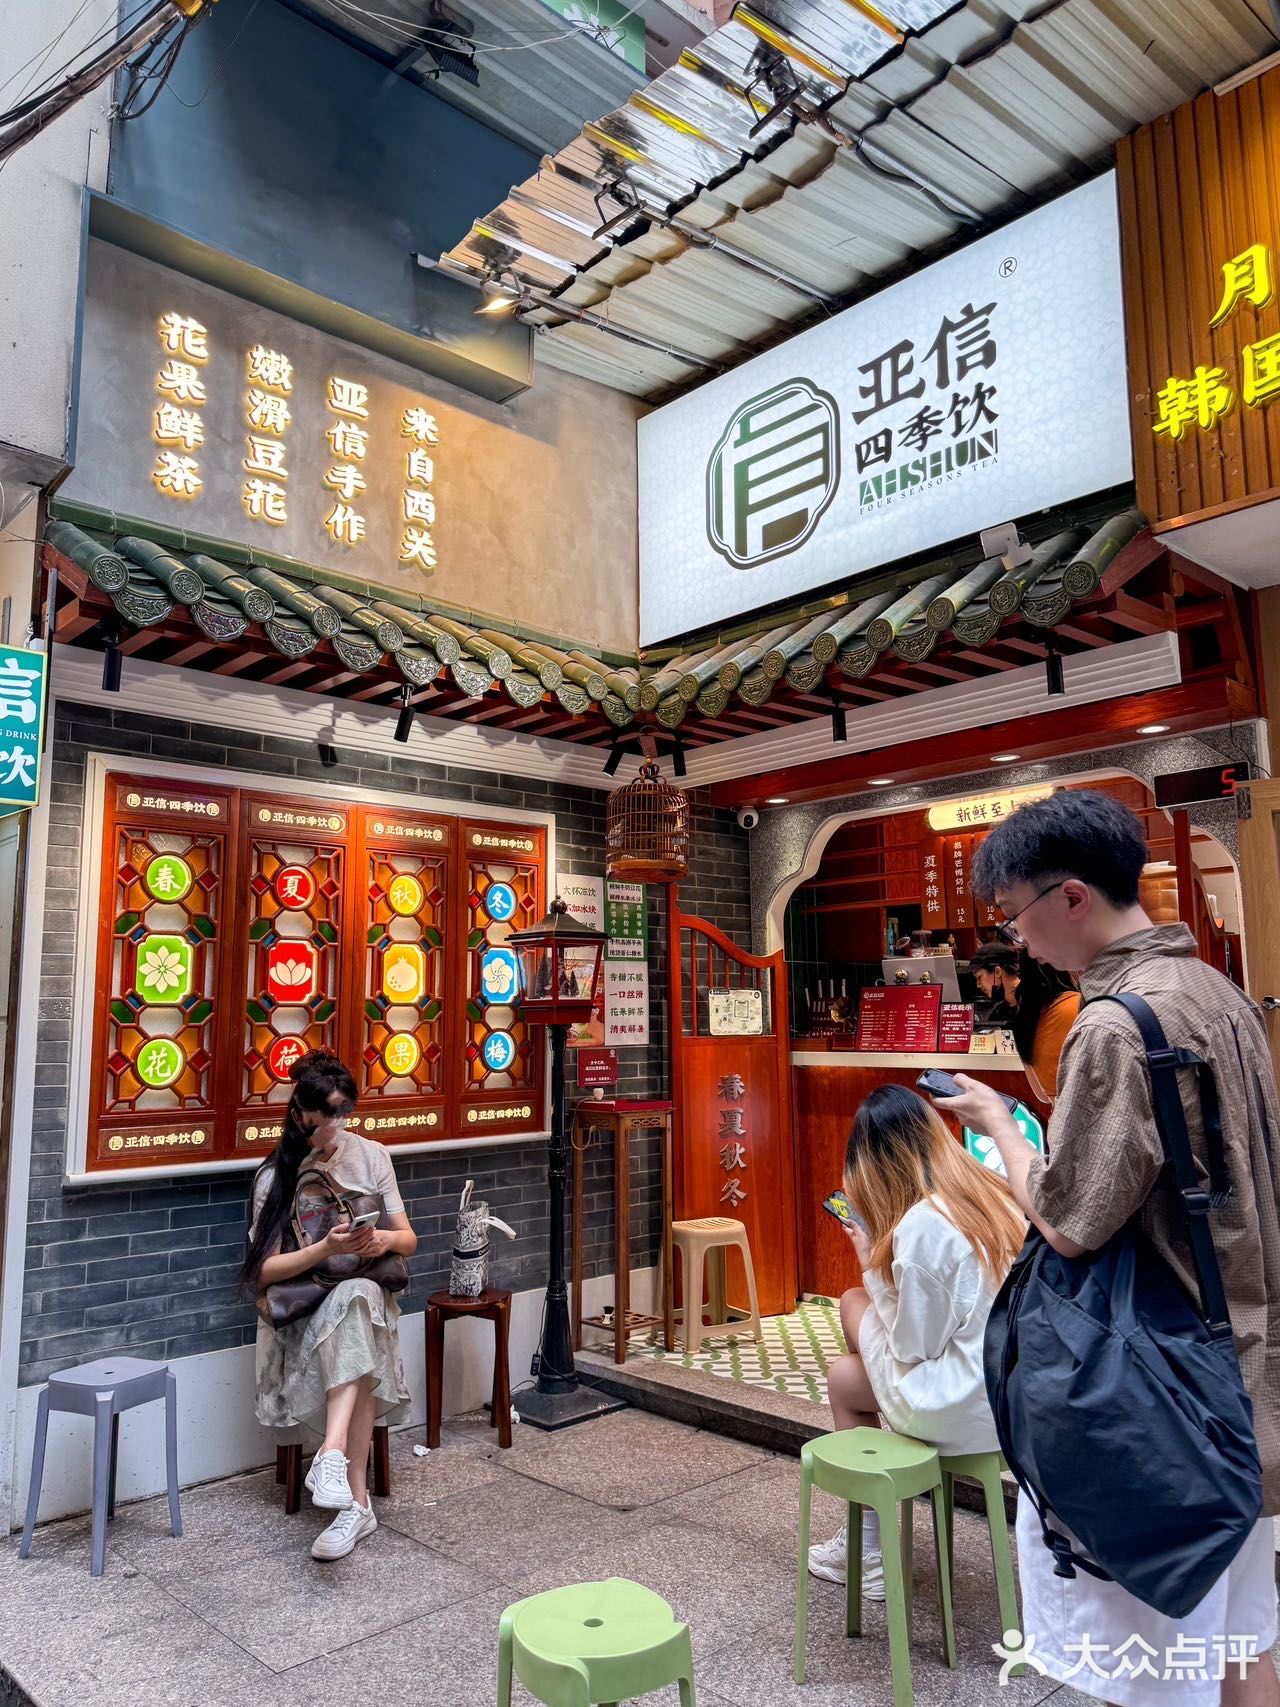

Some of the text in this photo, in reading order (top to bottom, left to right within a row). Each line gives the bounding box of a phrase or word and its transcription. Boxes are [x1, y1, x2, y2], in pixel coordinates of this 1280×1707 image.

[1208, 244, 1271, 327] 月
[851, 302, 998, 425] 亚信
[153, 312, 208, 495] 花果鲜茶
[243, 345, 293, 522] 嫩滑豆花
[855, 382, 1000, 474] 四季饮
[324, 377, 370, 543] 亚信手作
[399, 407, 438, 567] 来自西关
[859, 457, 999, 516] FOUR SEASONS TEA
[6, 729, 37, 741] DRINK
[152, 864, 182, 893] 春
[282, 875, 306, 901] 夏
[924, 855, 940, 913] 夏季特供
[392, 883, 414, 907] 秋
[488, 891, 510, 914] 冬
[609, 990, 643, 999] 一口丝滑
[610, 1007, 644, 1016] 花果鲜茶
[143, 1047, 172, 1078] 花
[275, 1044, 300, 1071] 荷
[392, 1042, 412, 1066] 果
[487, 1039, 507, 1062] 梅
[718, 1072, 747, 1207] 春夏秋冬
